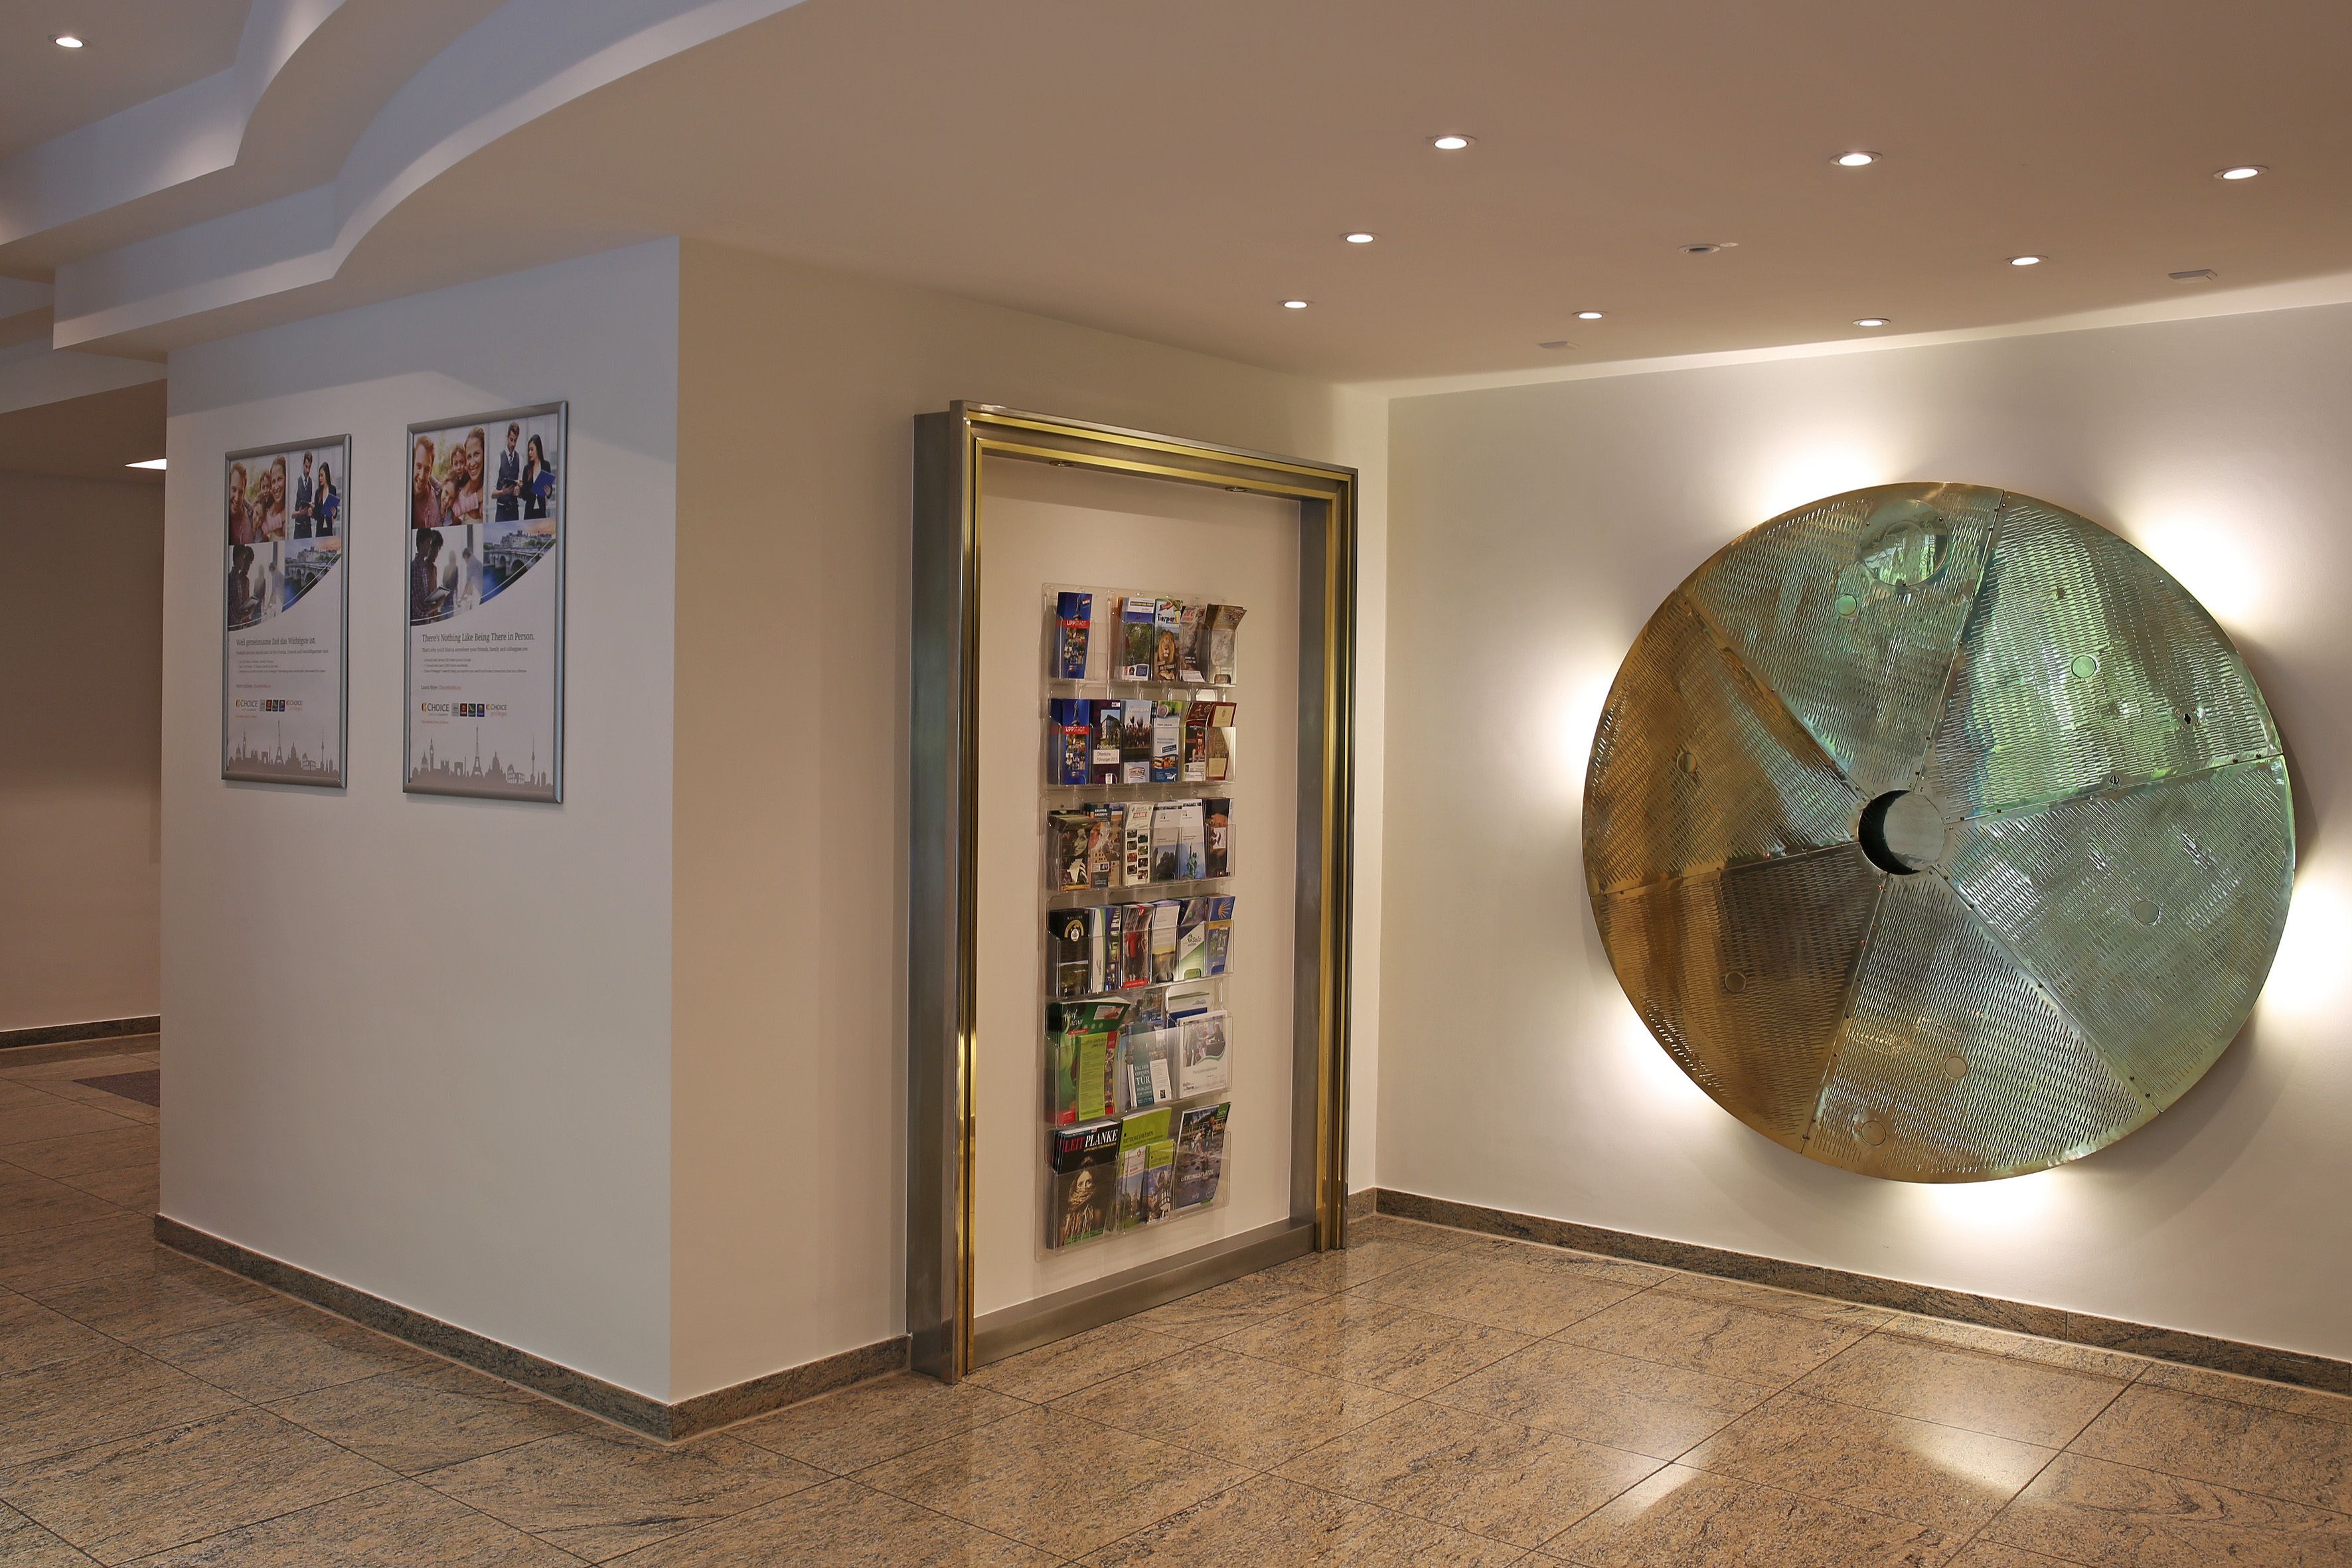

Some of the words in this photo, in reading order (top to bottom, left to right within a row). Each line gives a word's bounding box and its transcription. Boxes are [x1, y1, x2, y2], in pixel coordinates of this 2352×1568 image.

[1157, 613, 1178, 624] Tierpark
[288, 637, 309, 646] Wichtigste
[422, 634, 439, 643] There's
[441, 633, 461, 643] Nothing
[461, 633, 473, 641] Like
[474, 633, 490, 643] Being
[491, 632, 507, 641] There
[508, 632, 514, 641] in
[514, 632, 535, 641] Person.
[427, 702, 449, 712] CHOICE
[1135, 1075, 1150, 1085] TÜR
[1064, 1137, 1085, 1153] LEIT
[1085, 1129, 1118, 1148] PLANKE
[1180, 1168, 1214, 1182] LIEBLINGSPLÄTZE
